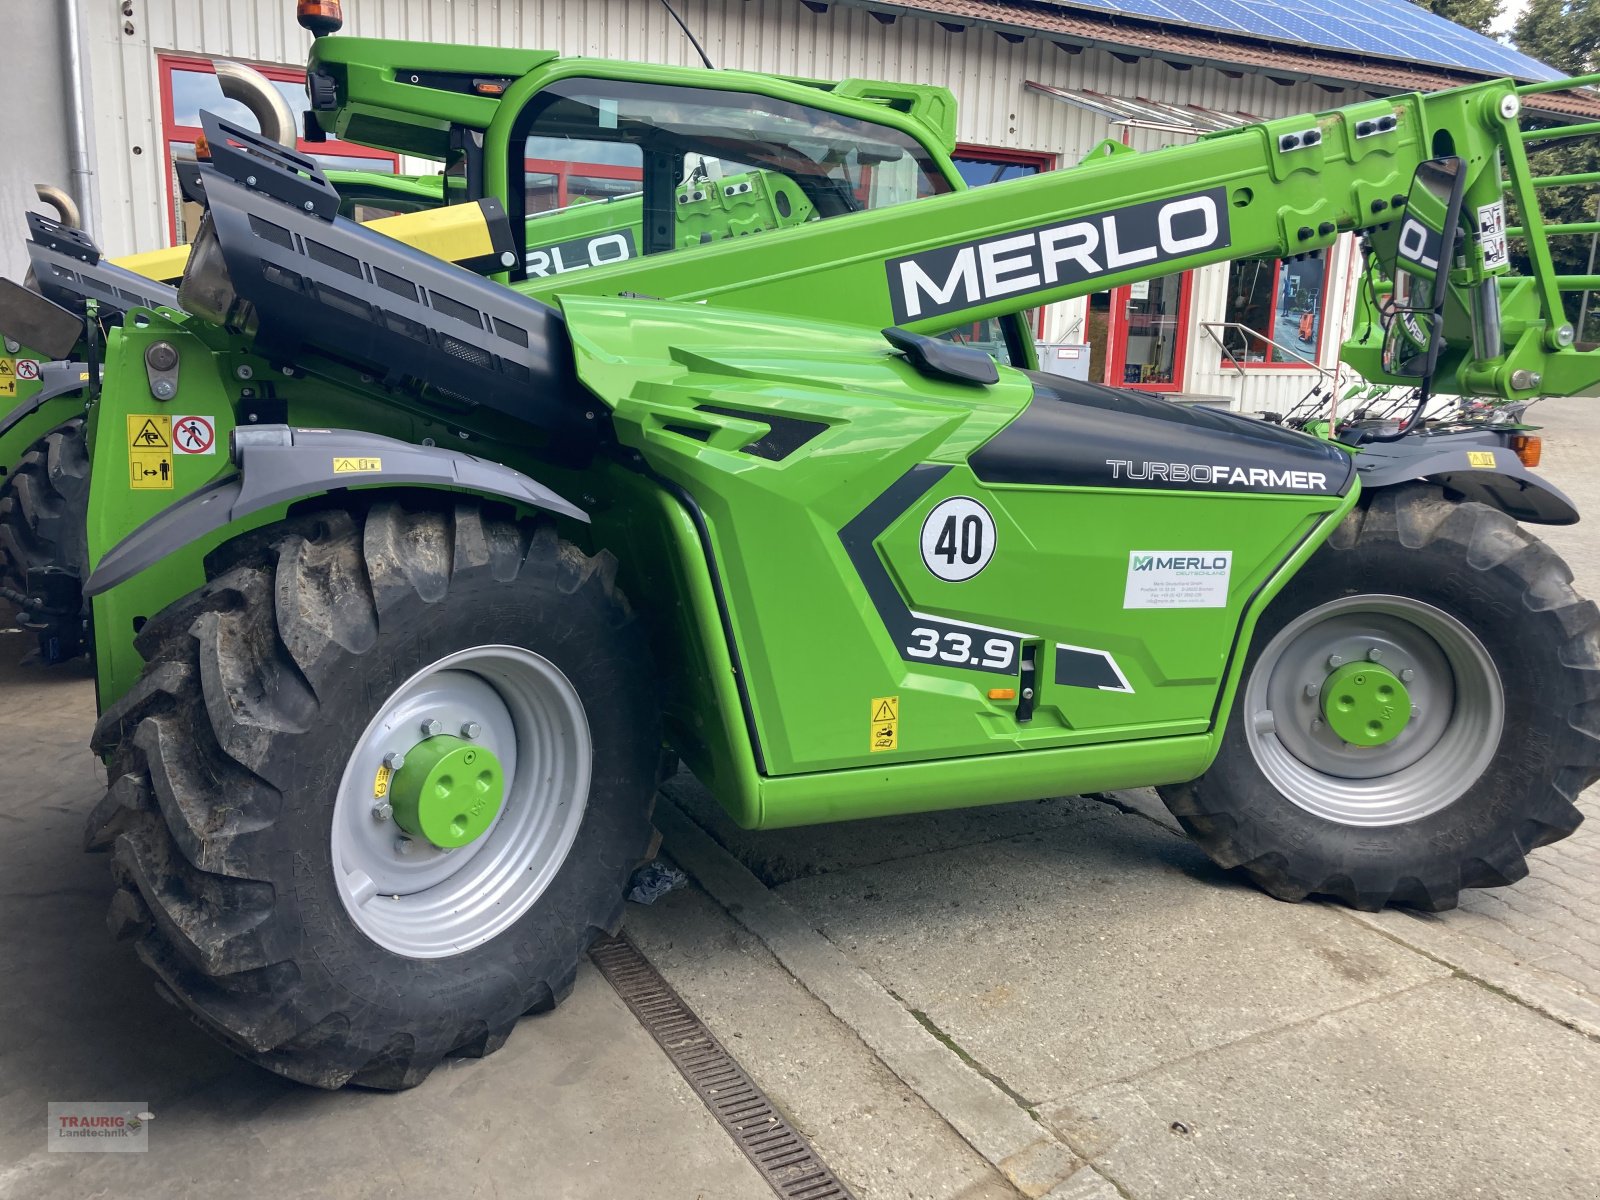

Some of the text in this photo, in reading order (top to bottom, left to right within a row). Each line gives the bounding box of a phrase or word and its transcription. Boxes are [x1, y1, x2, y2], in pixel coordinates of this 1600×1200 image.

[899, 196, 1219, 317] MERLO
[1105, 459, 1327, 490] TURBOFARMER
[934, 514, 983, 565] 40
[1155, 557, 1227, 570] MERLO
[906, 627, 1015, 669] 33.9
